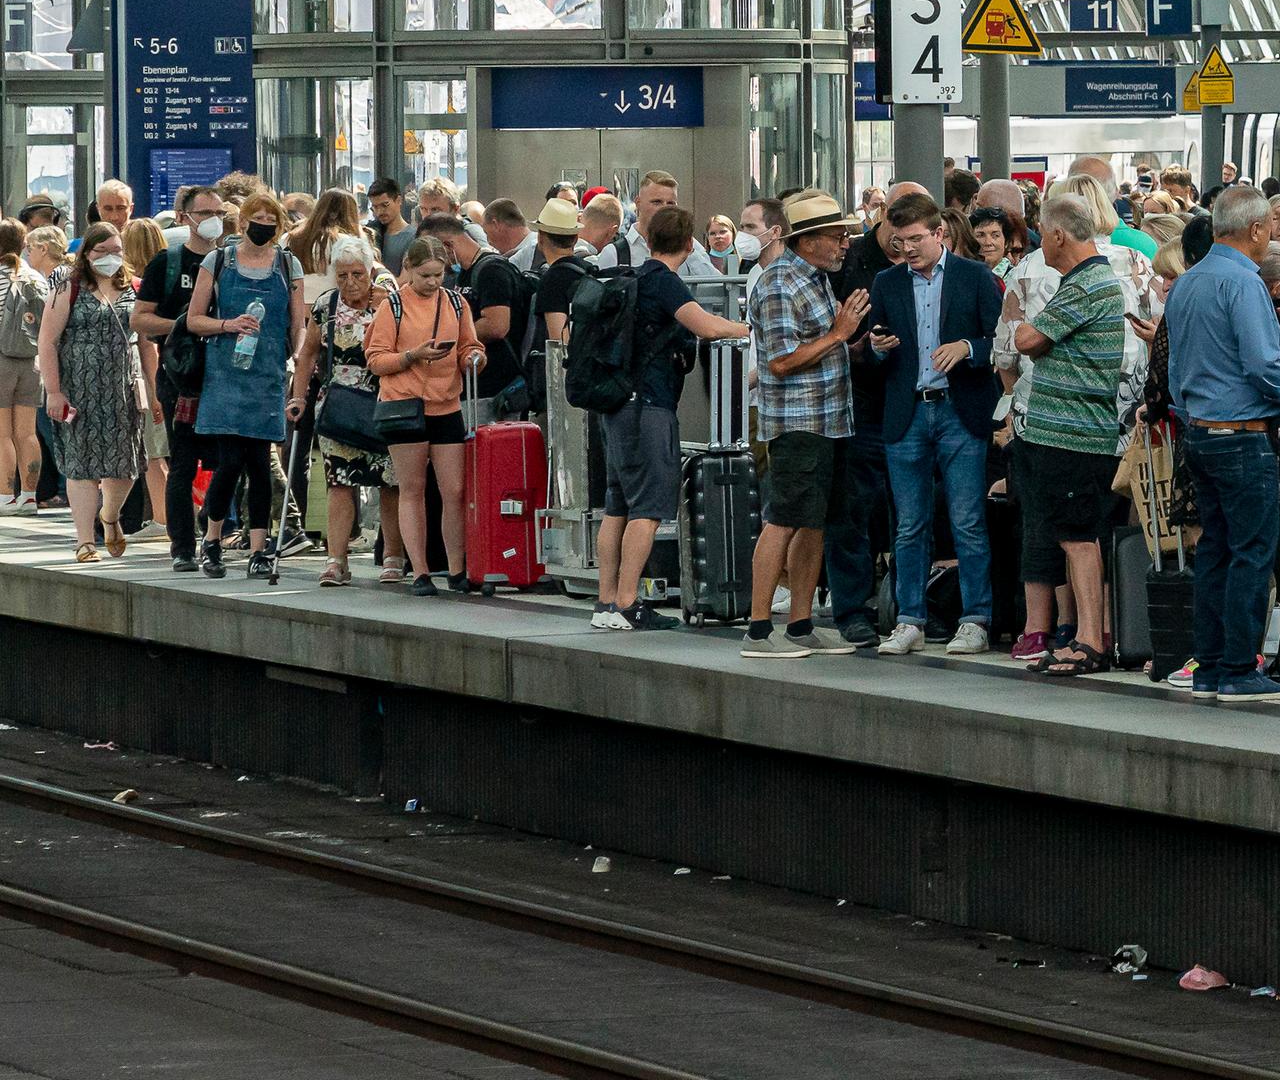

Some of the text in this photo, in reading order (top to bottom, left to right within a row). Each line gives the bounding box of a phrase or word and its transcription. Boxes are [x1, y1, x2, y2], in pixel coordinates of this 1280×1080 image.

[1087, 0, 1113, 29] 11
[150, 37, 179, 55] 5-6
[910, 34, 944, 83] 4
[142, 65, 188, 76] Ebenenplan
[940, 85, 957, 96] 392
[1086, 81, 1159, 92] Wagenreihungsplan
[165, 97, 187, 105] Zugang
[639, 84, 677, 110] 3/4
[1108, 92, 1159, 101] Abschnitt F-G
[165, 122, 187, 130] Zugang
